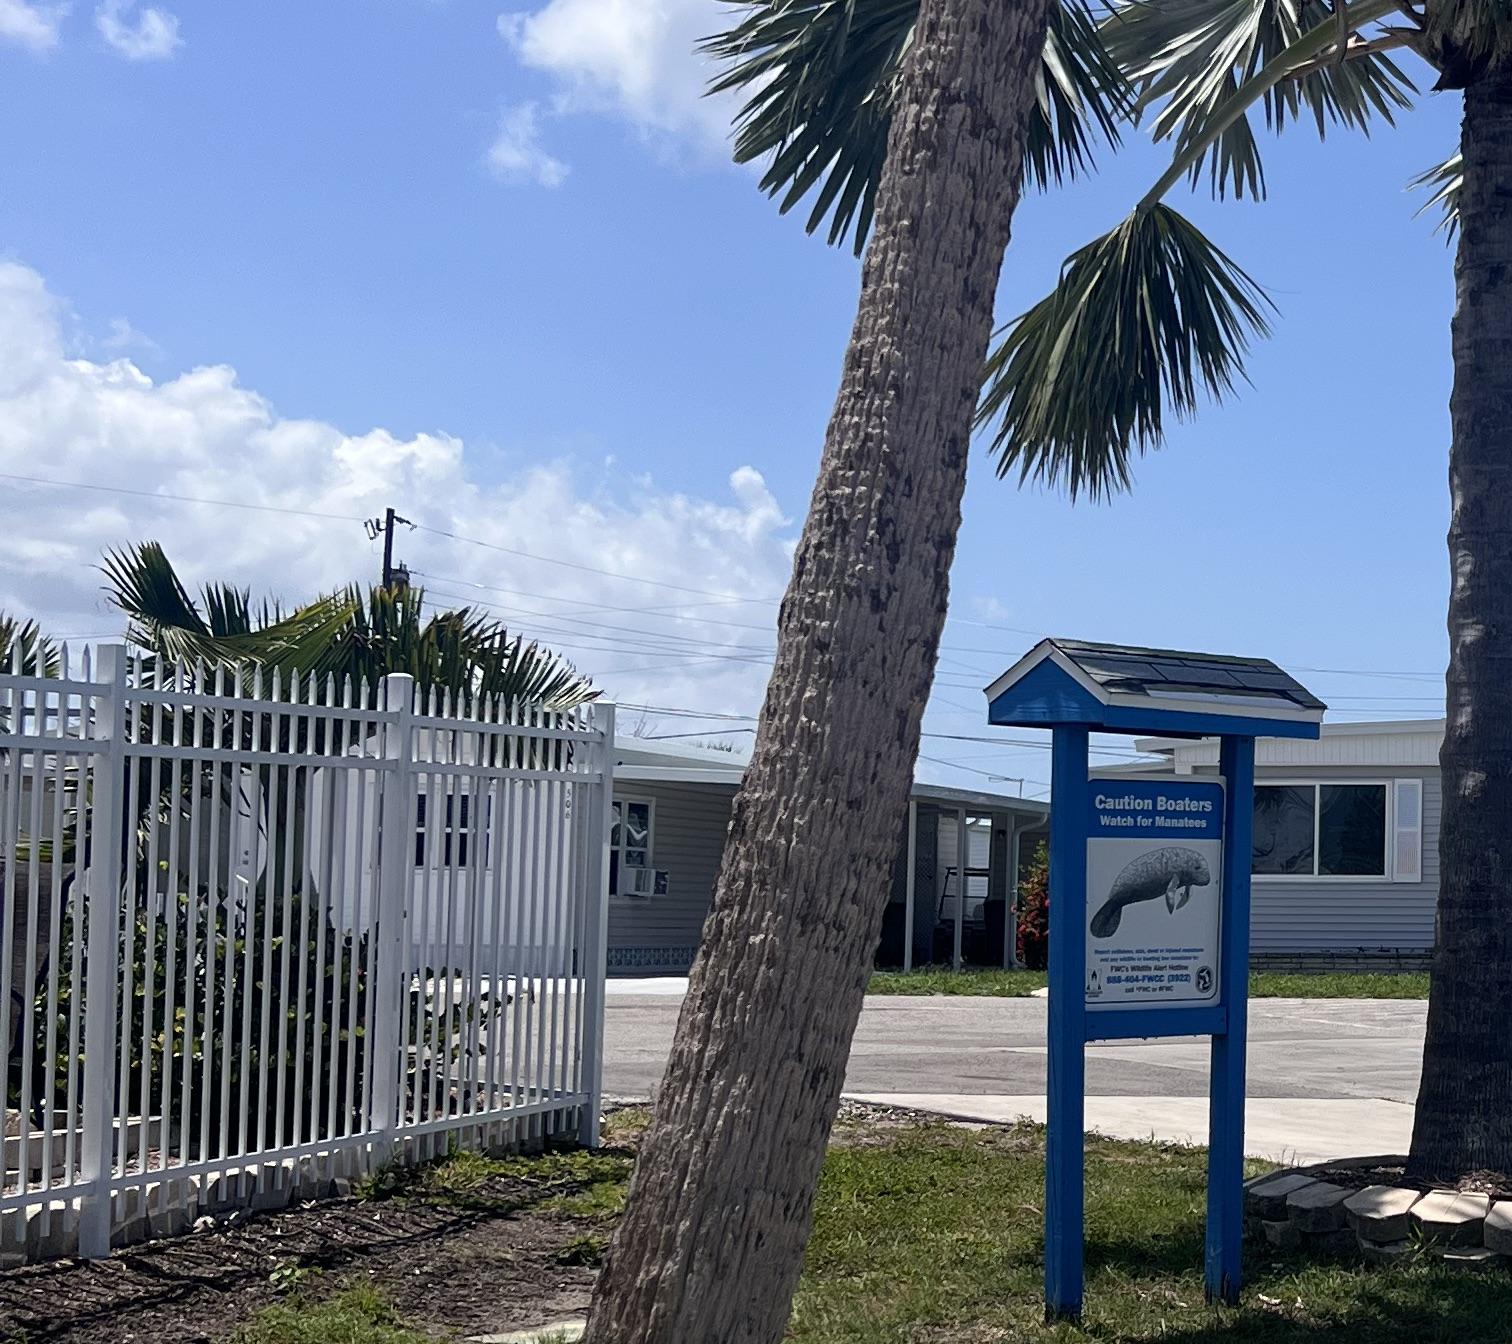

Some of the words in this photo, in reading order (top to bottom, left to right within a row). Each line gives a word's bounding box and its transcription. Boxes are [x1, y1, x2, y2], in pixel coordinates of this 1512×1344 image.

[1095, 794, 1152, 810] Caution
[1157, 796, 1212, 811] Boaters
[1100, 815, 1134, 826] Watch
[1137, 816, 1152, 826] for
[1155, 816, 1207, 828] Manatees
